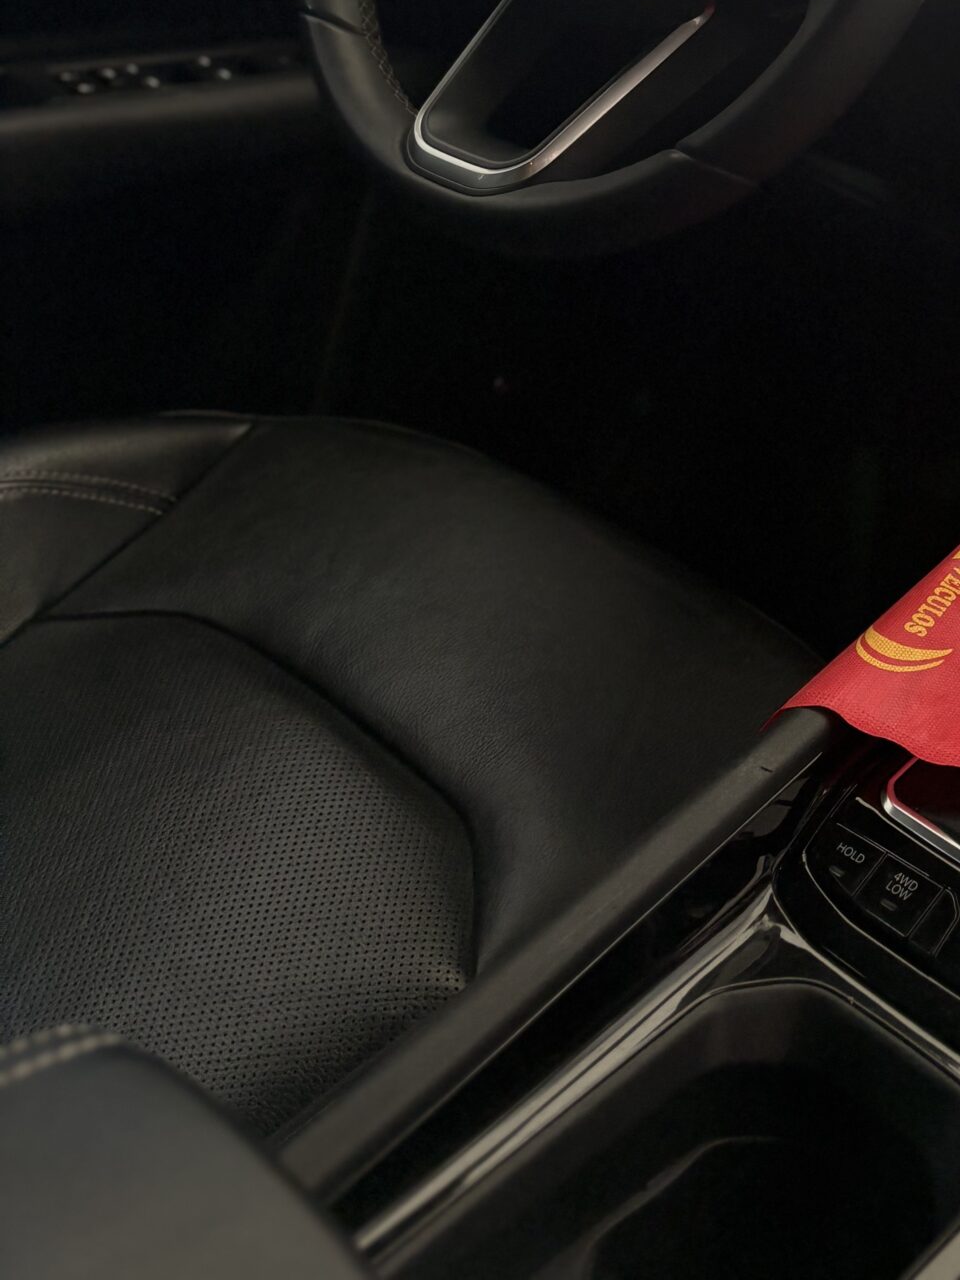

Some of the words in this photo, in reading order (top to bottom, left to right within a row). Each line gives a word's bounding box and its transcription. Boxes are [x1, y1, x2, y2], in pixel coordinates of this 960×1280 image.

[836, 842, 866, 864] HOLD
[885, 880, 913, 901] LOW
[893, 871, 919, 892] 4WD
